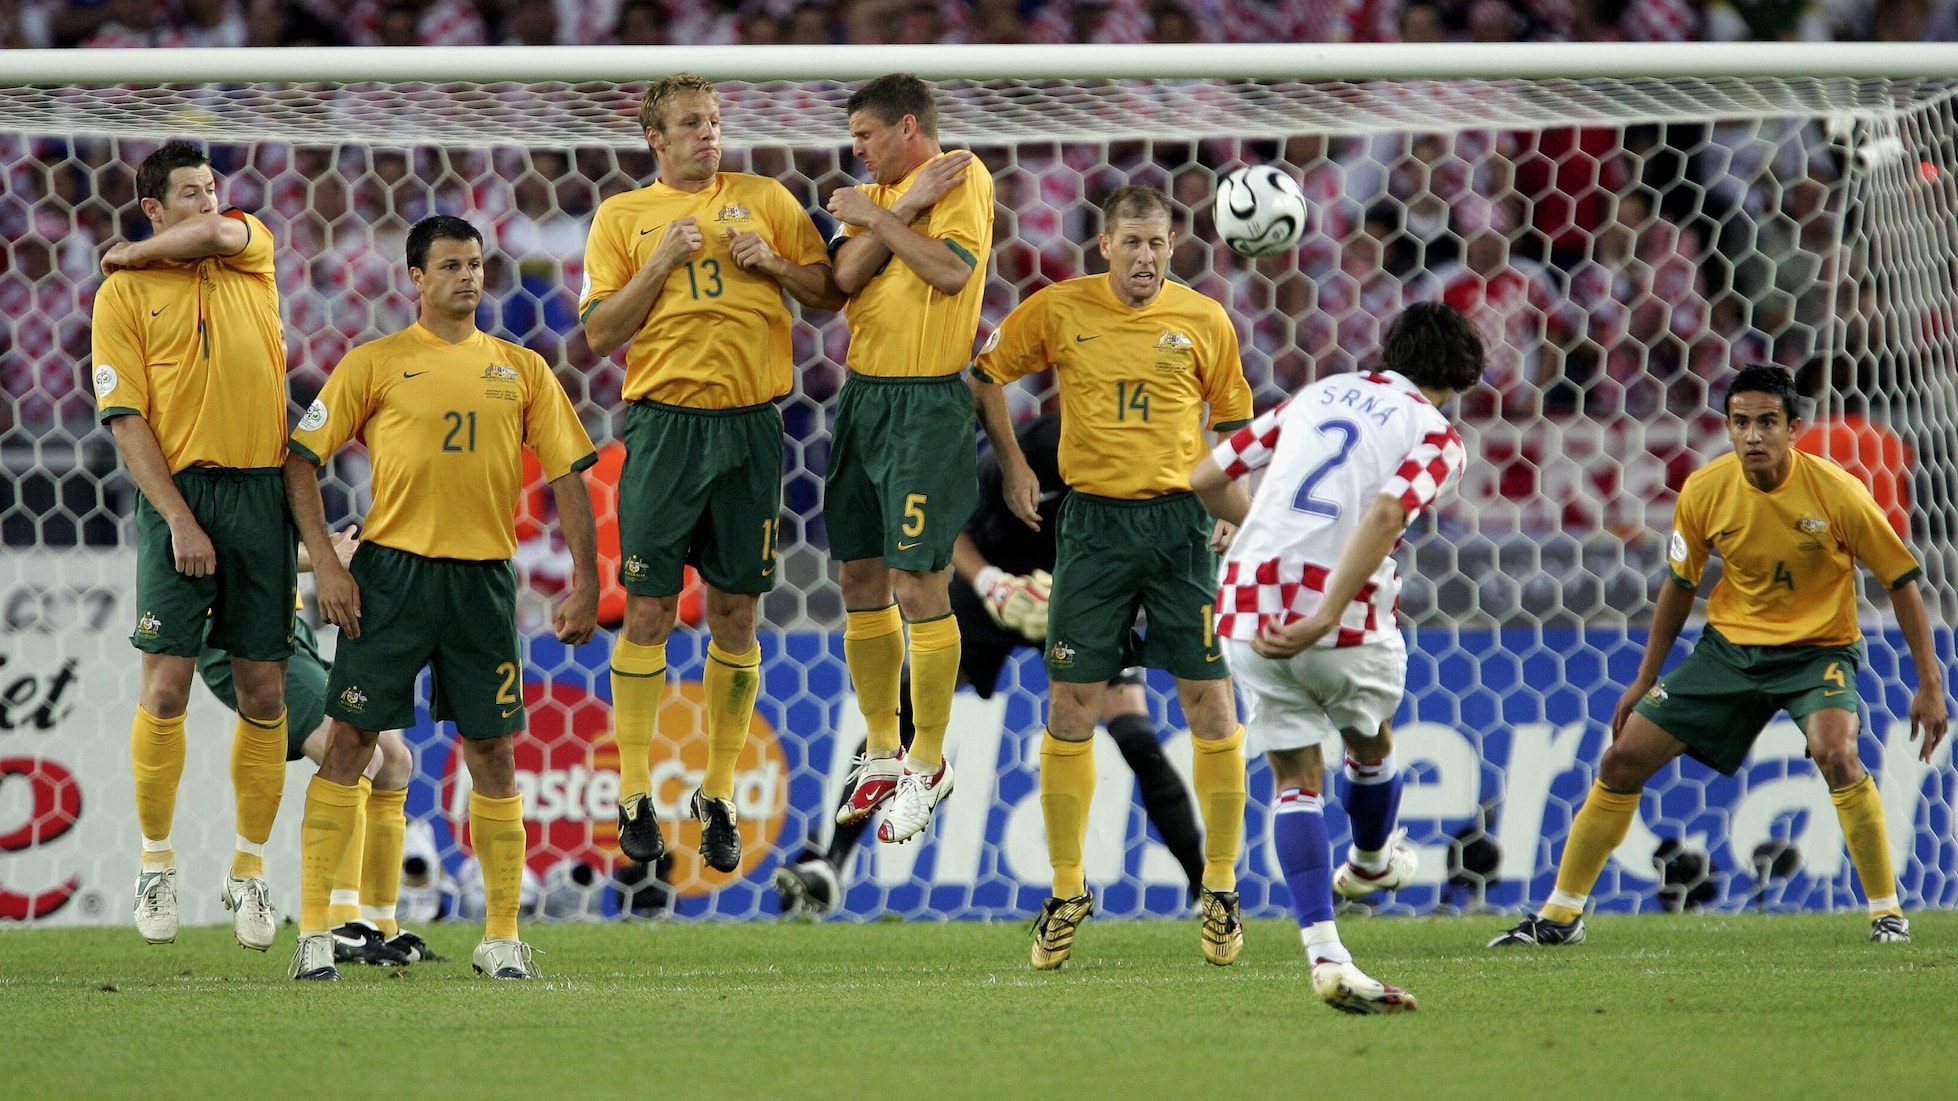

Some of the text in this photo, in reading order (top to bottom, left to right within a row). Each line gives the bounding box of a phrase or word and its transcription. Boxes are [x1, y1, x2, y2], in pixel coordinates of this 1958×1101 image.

[685, 257, 724, 300] 13
[1116, 381, 1149, 422] 14
[1320, 386, 1399, 426] SRNA
[442, 410, 476, 453] 21
[1290, 416, 1362, 520] 2
[901, 493, 928, 538] 5
[1774, 562, 1794, 591] 4
[0, 652, 78, 731] et
[495, 658, 523, 704] 2
[1823, 661, 1845, 688] 4
